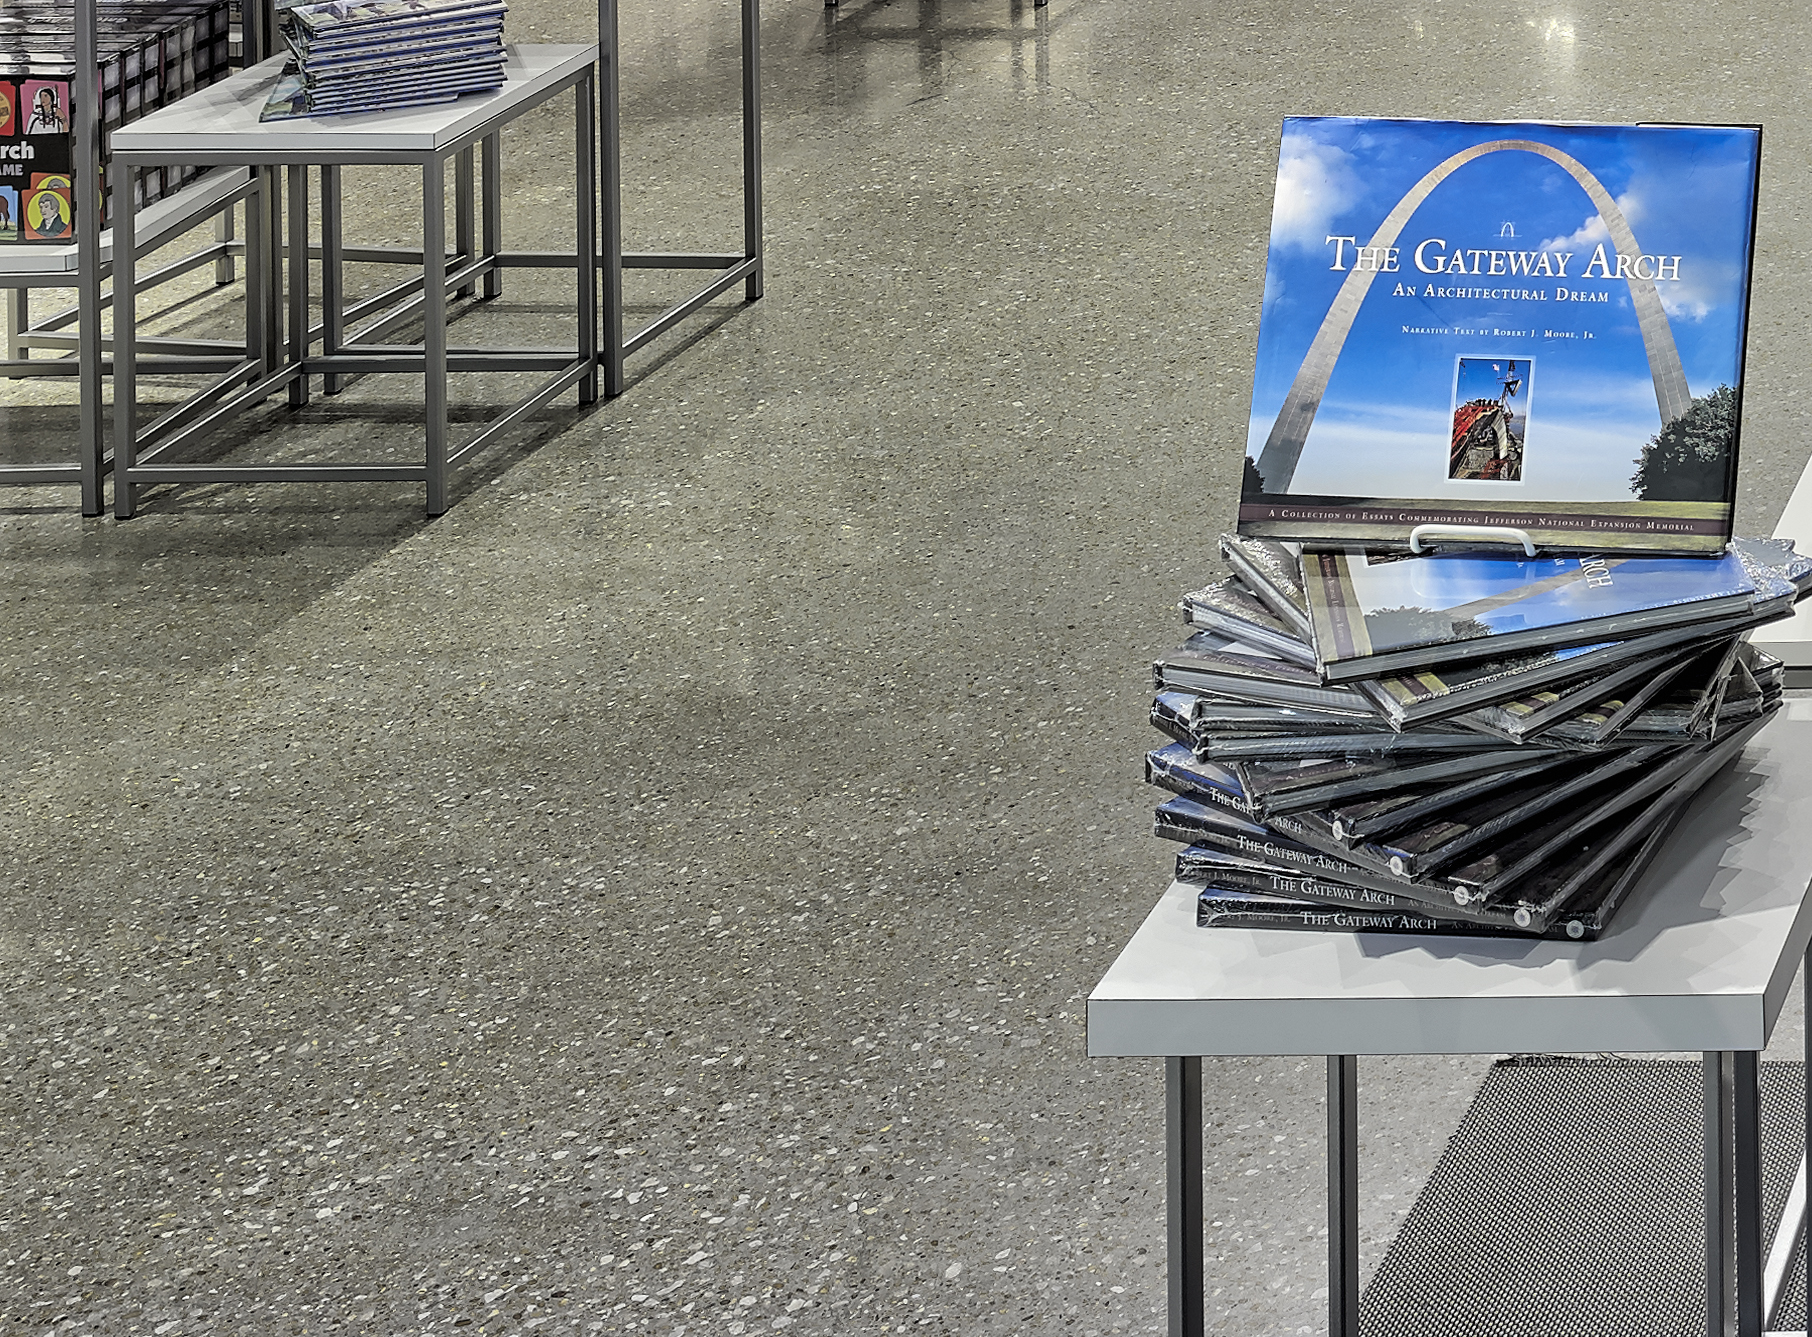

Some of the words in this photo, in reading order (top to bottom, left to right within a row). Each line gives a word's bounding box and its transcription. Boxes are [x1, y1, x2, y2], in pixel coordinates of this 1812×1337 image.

[1324, 233, 1400, 272] THE
[1414, 237, 1572, 279] GATEWAY
[1580, 242, 1682, 281] ARCH
[1392, 282, 1416, 298] AN
[1423, 283, 1548, 303] ARCHITECTURAL
[1555, 287, 1609, 303] DREAM
